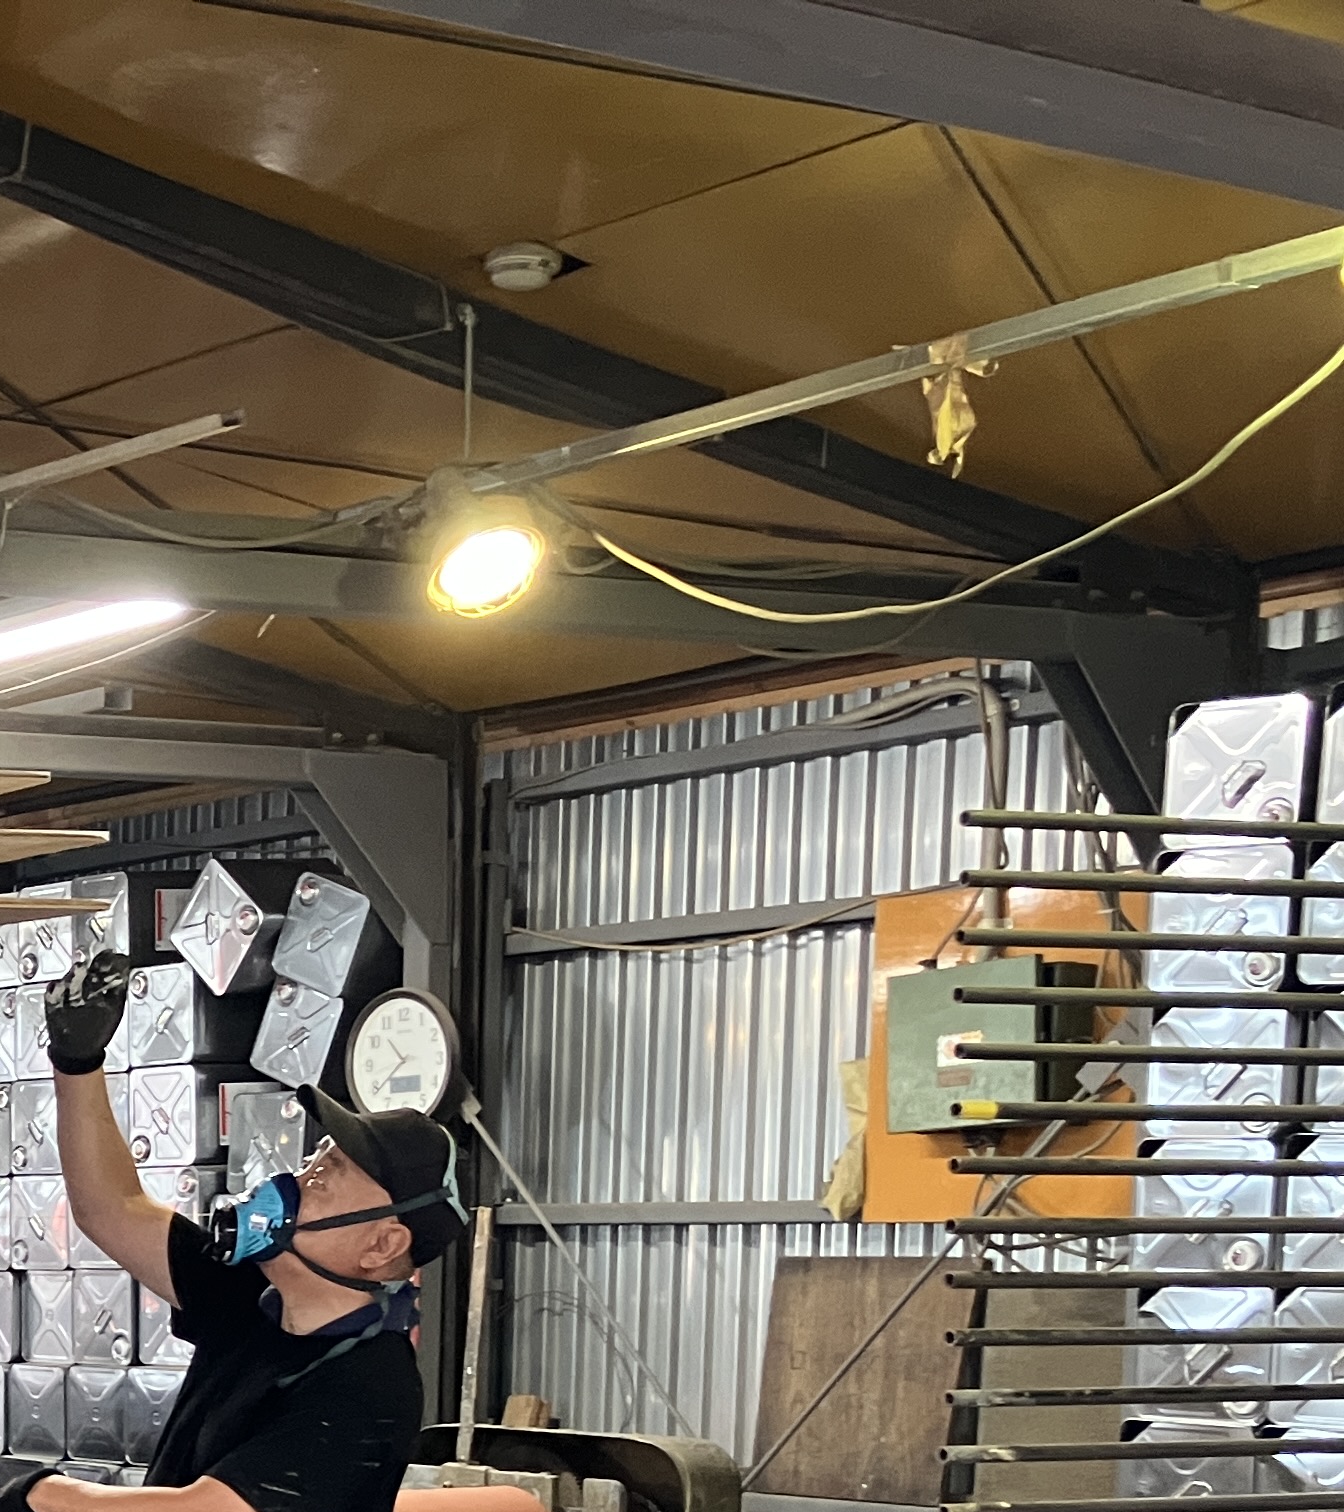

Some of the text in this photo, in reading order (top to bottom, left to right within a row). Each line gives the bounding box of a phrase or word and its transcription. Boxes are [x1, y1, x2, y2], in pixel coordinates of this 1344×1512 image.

[398, 1007, 410, 1022] 12
[381, 1016, 392, 1030] 11
[368, 1035, 381, 1049] 10
[430, 1028, 439, 1042] 2
[435, 1051, 444, 1066] 3
[365, 1059, 374, 1073] 9
[418, 1093, 427, 1108] 5
